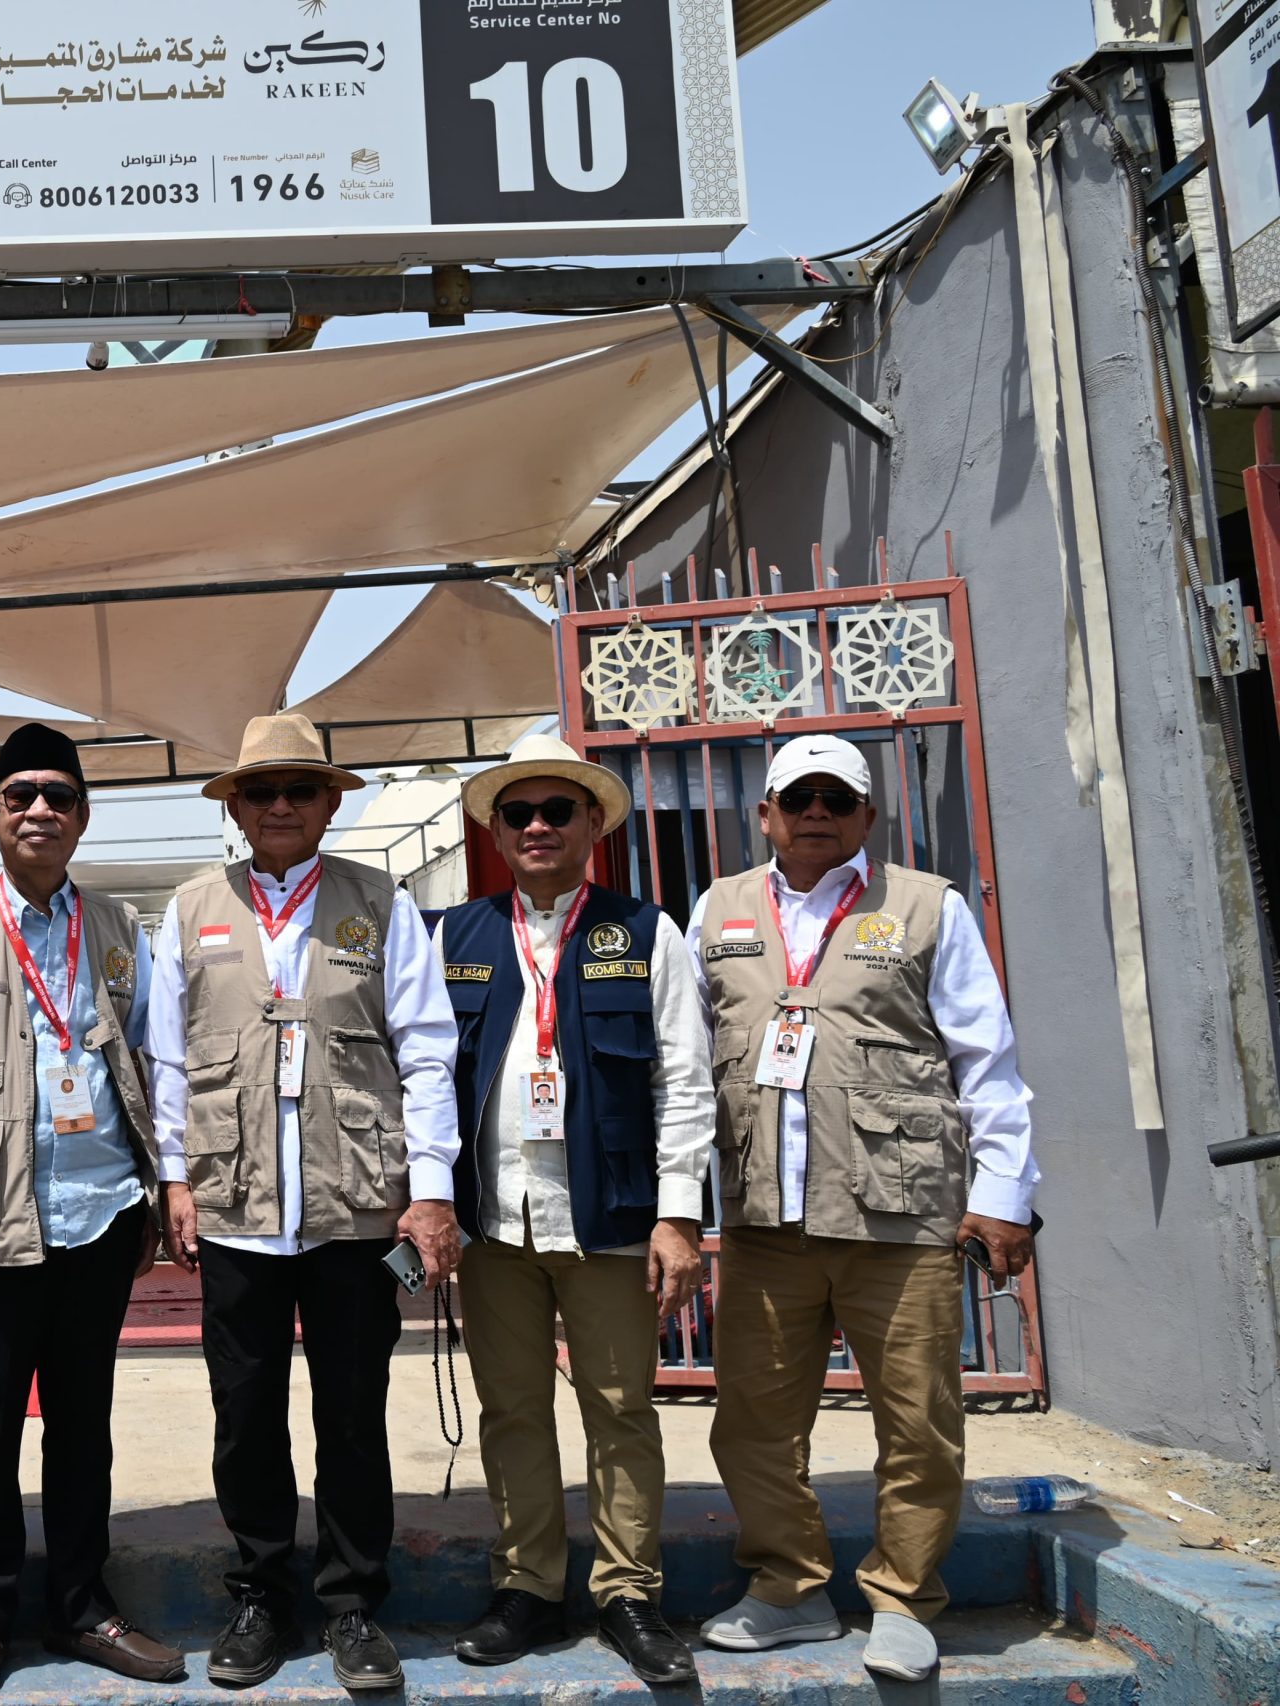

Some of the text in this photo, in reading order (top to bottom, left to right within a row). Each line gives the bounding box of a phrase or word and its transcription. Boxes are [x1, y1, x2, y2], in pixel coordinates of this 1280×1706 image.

[470, 11, 620, 29] Service Center No
[86, 37, 162, 72] مشارق
[166, 34, 227, 69] شركة
[116, 74, 226, 102] لخدمات
[266, 81, 366, 99] RAKEEN
[469, 57, 628, 193] 10
[21, 158, 58, 168] Center
[121, 153, 197, 168] مركز التواصل
[40, 182, 200, 208] 8006120033
[230, 173, 324, 202] 1966
[340, 190, 395, 200] Nusuk Care
[720, 944, 759, 954] WACHID
[328, 958, 382, 974] TIMWAS HAJI
[843, 953, 911, 968] TIMWAS HAJI
[866, 963, 888, 971] 2024
[349, 969, 368, 977] 2024
[446, 967, 489, 978] ACE HASAN
[587, 963, 644, 977] KOMISI VIII
